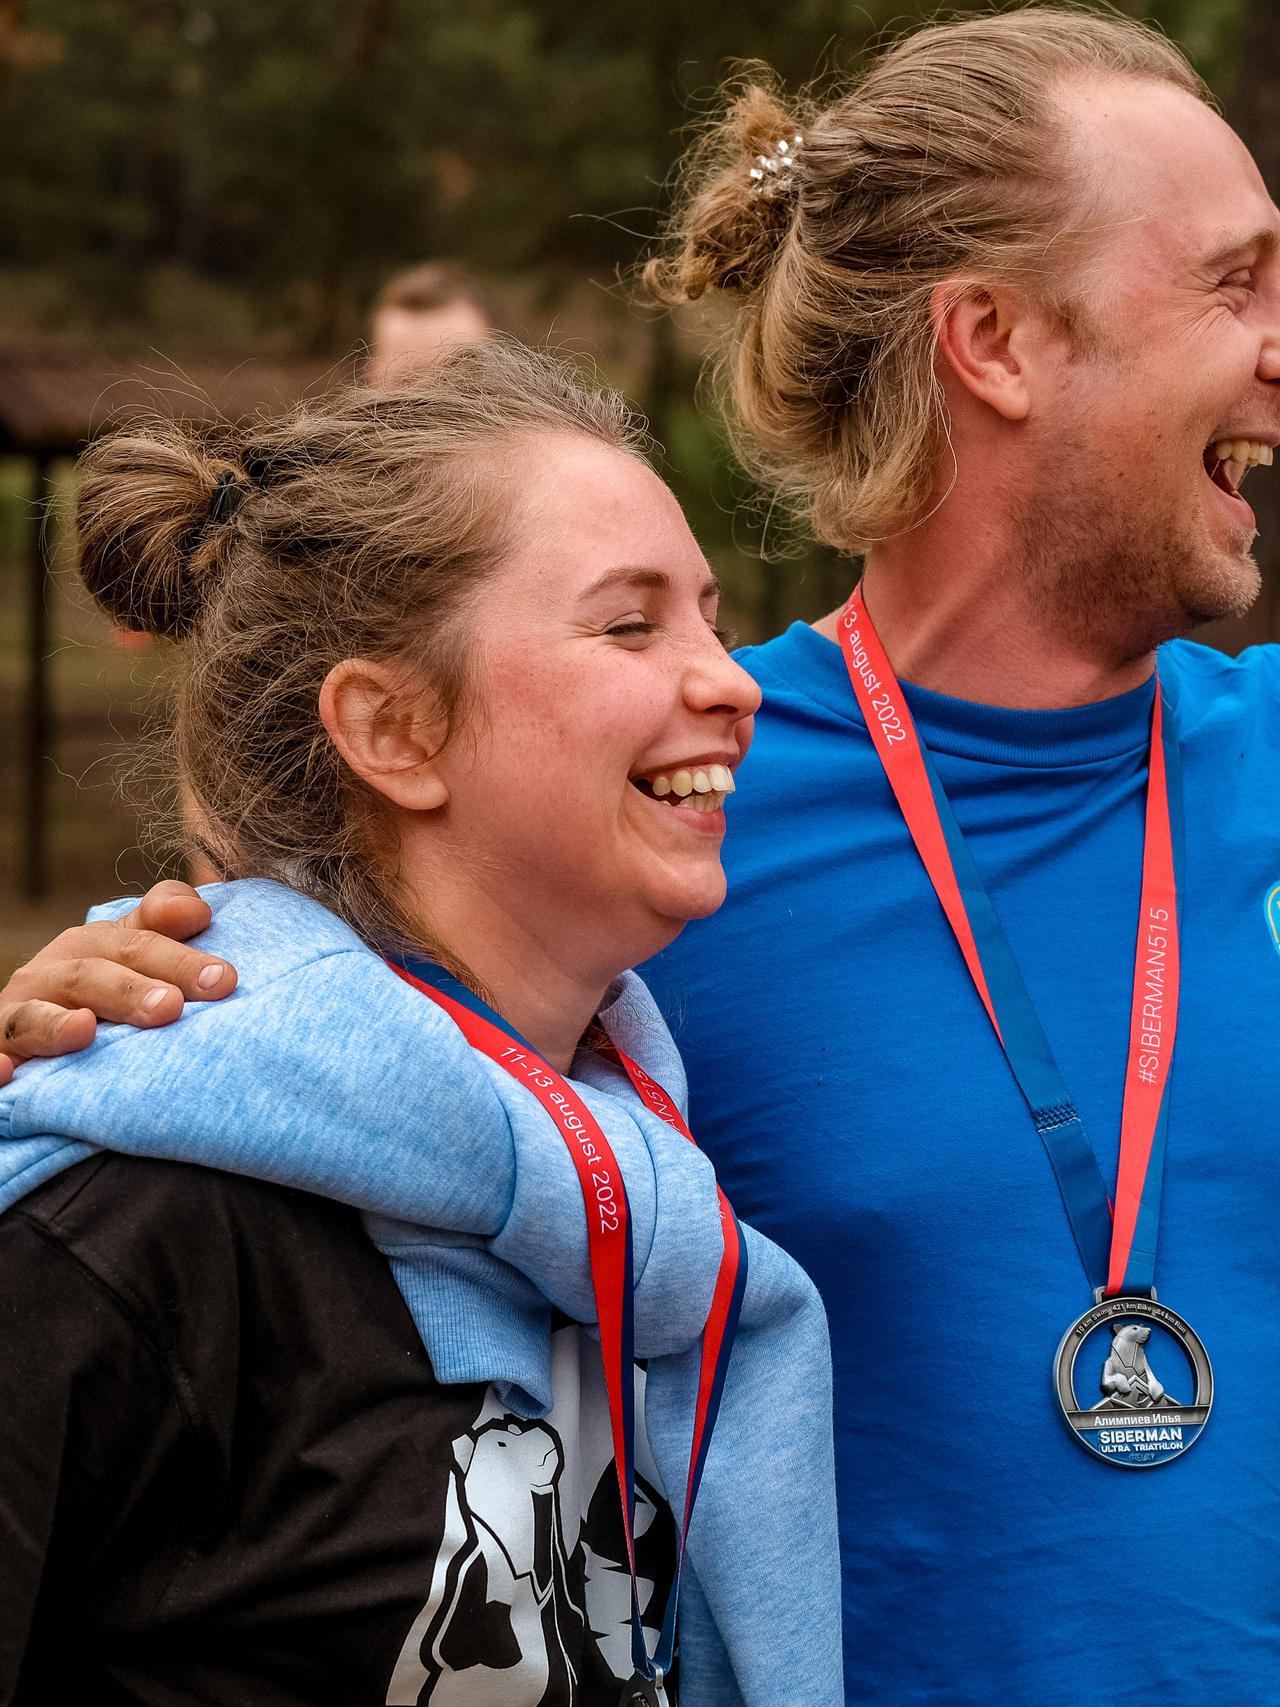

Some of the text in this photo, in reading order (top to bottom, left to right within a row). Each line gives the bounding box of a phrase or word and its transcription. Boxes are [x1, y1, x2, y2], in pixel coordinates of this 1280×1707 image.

[849, 630, 882, 695] august
[872, 694, 906, 746] 2022
[1138, 907, 1169, 1085] #SIBERMAN515
[500, 1046, 619, 1234] 11-13 august 2022
[1125, 1302, 1137, 1310] km
[1137, 1303, 1152, 1312] Bike
[1094, 1413, 1181, 1427] Алимпиев Илья
[1099, 1427, 1183, 1444] SIBERMAN
[1100, 1441, 1184, 1454] ULTRA TRIATHLON
